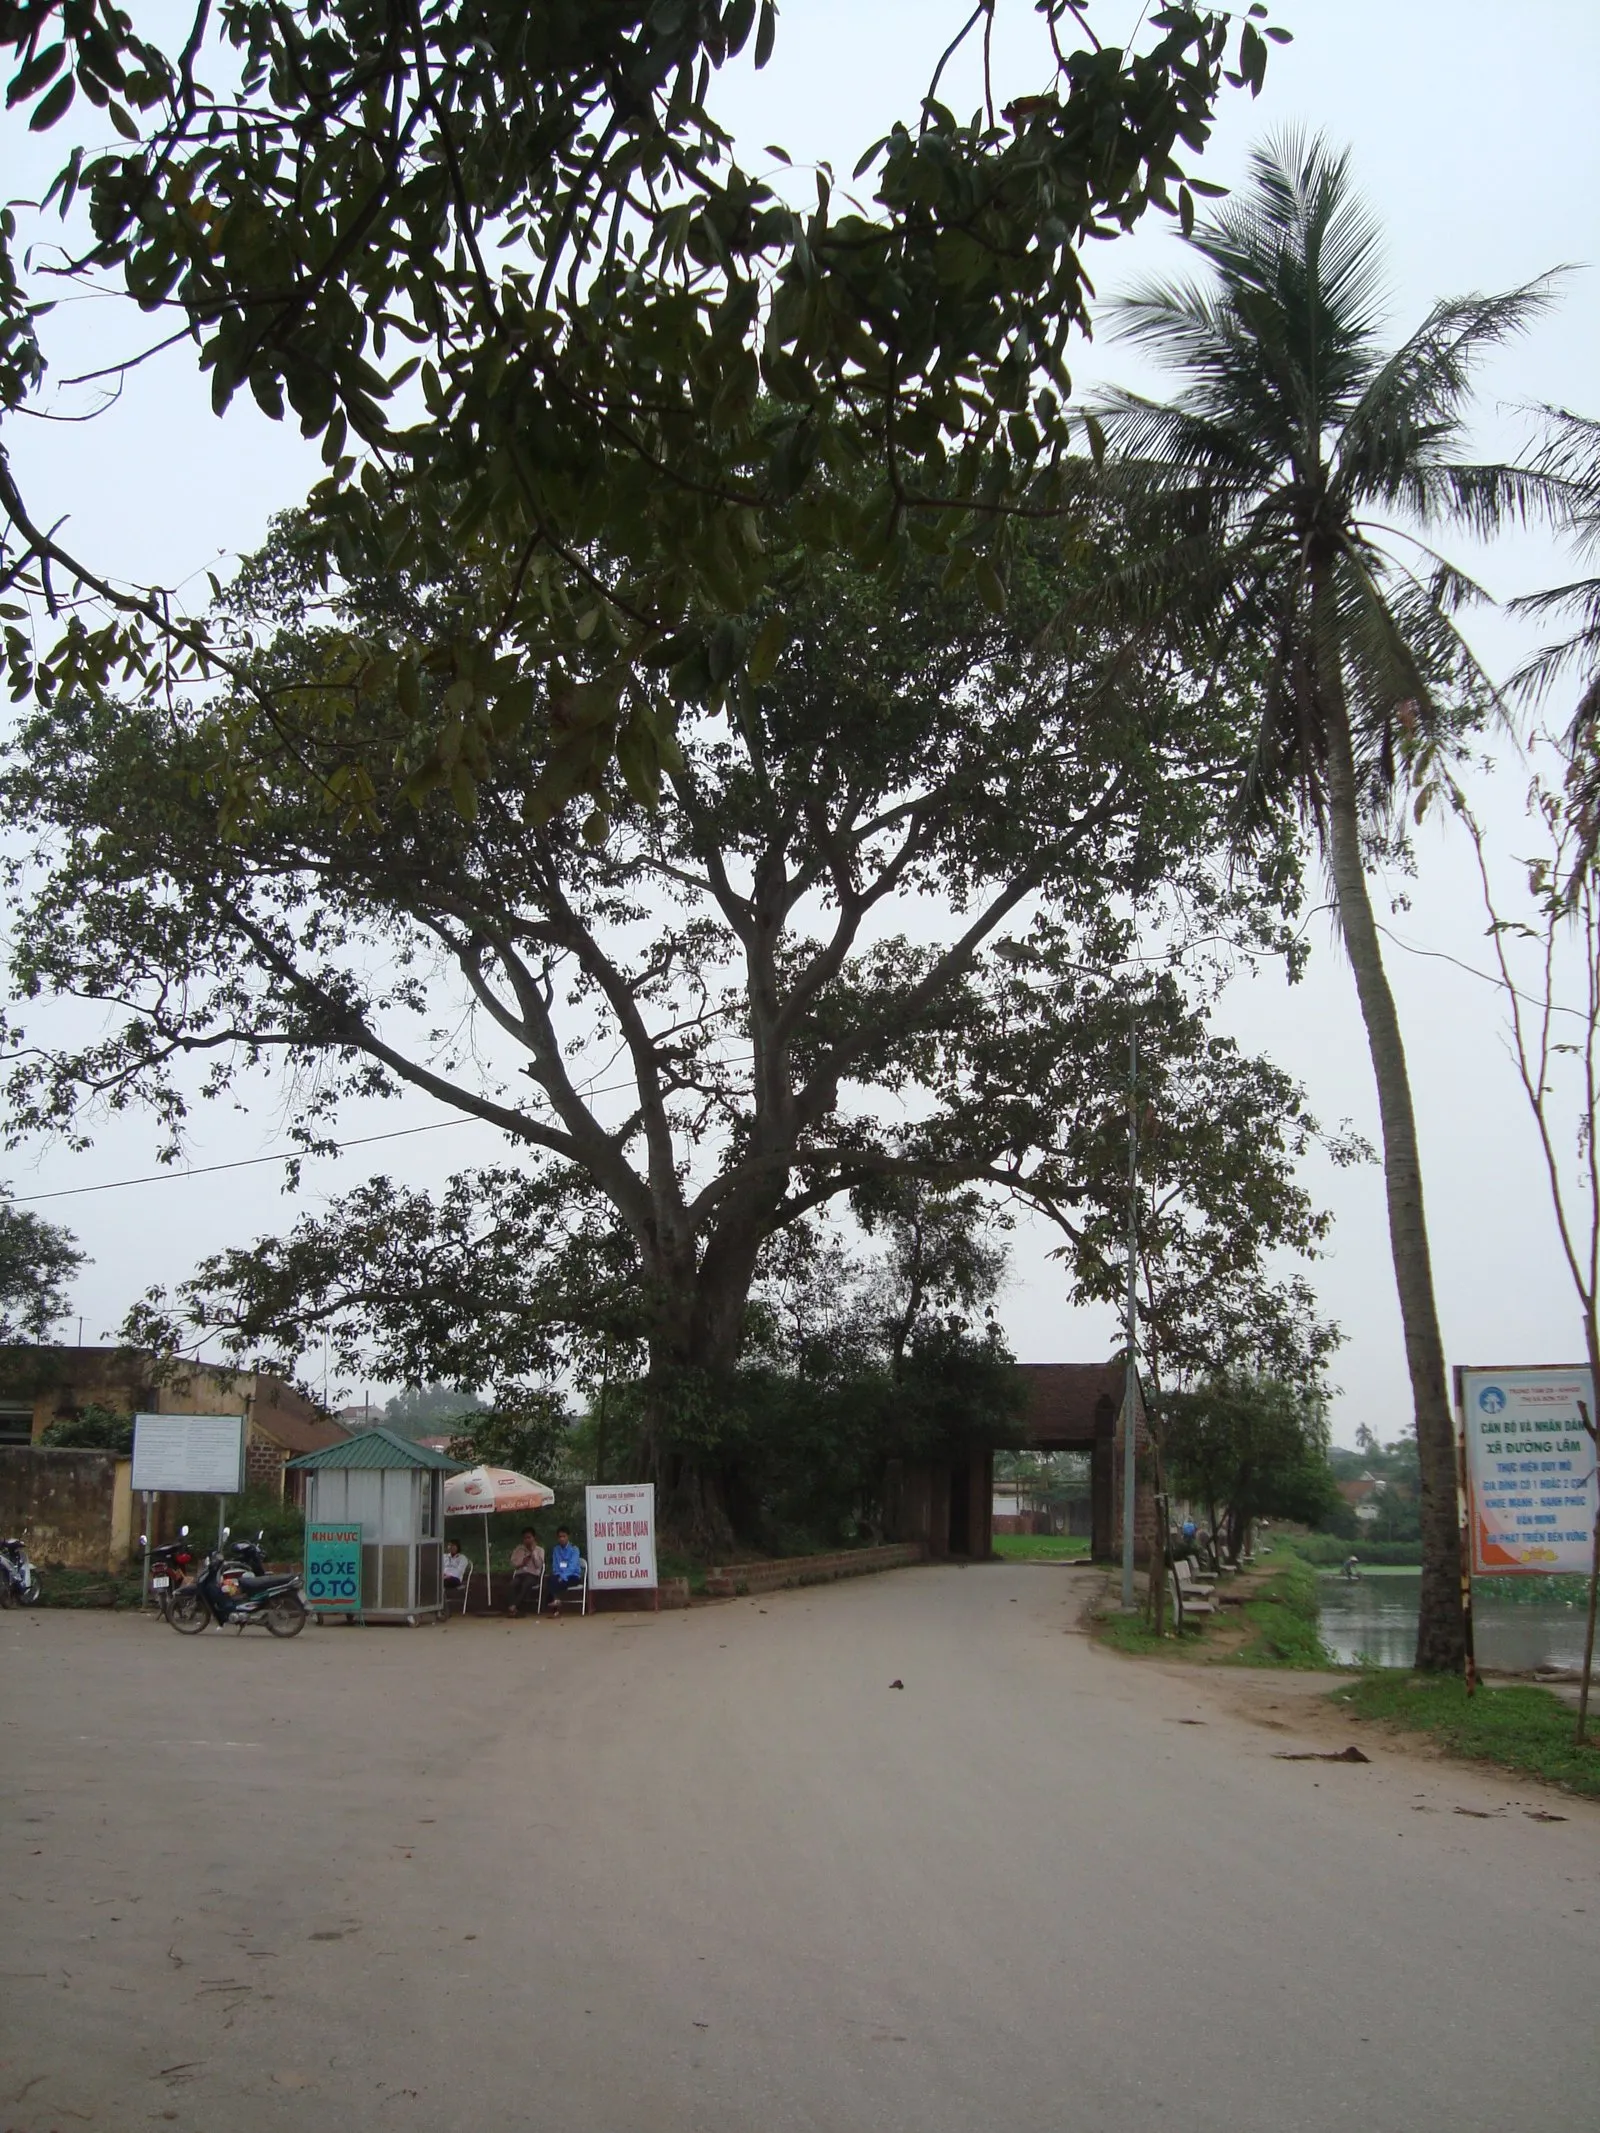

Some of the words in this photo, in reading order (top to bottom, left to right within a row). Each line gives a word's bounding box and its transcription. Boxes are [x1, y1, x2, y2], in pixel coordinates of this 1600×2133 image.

[1556, 1438, 1581, 1452] LÂM
[608, 1503, 634, 1515] NƠI
[615, 1520, 632, 1537] THAM
[632, 1520, 648, 1538] QUAN
[312, 1531, 334, 1542] KHU
[336, 1531, 358, 1544] VỰC
[607, 1542, 615, 1552] DI
[618, 1541, 637, 1552] TÍCH
[336, 1561, 356, 1575] XE
